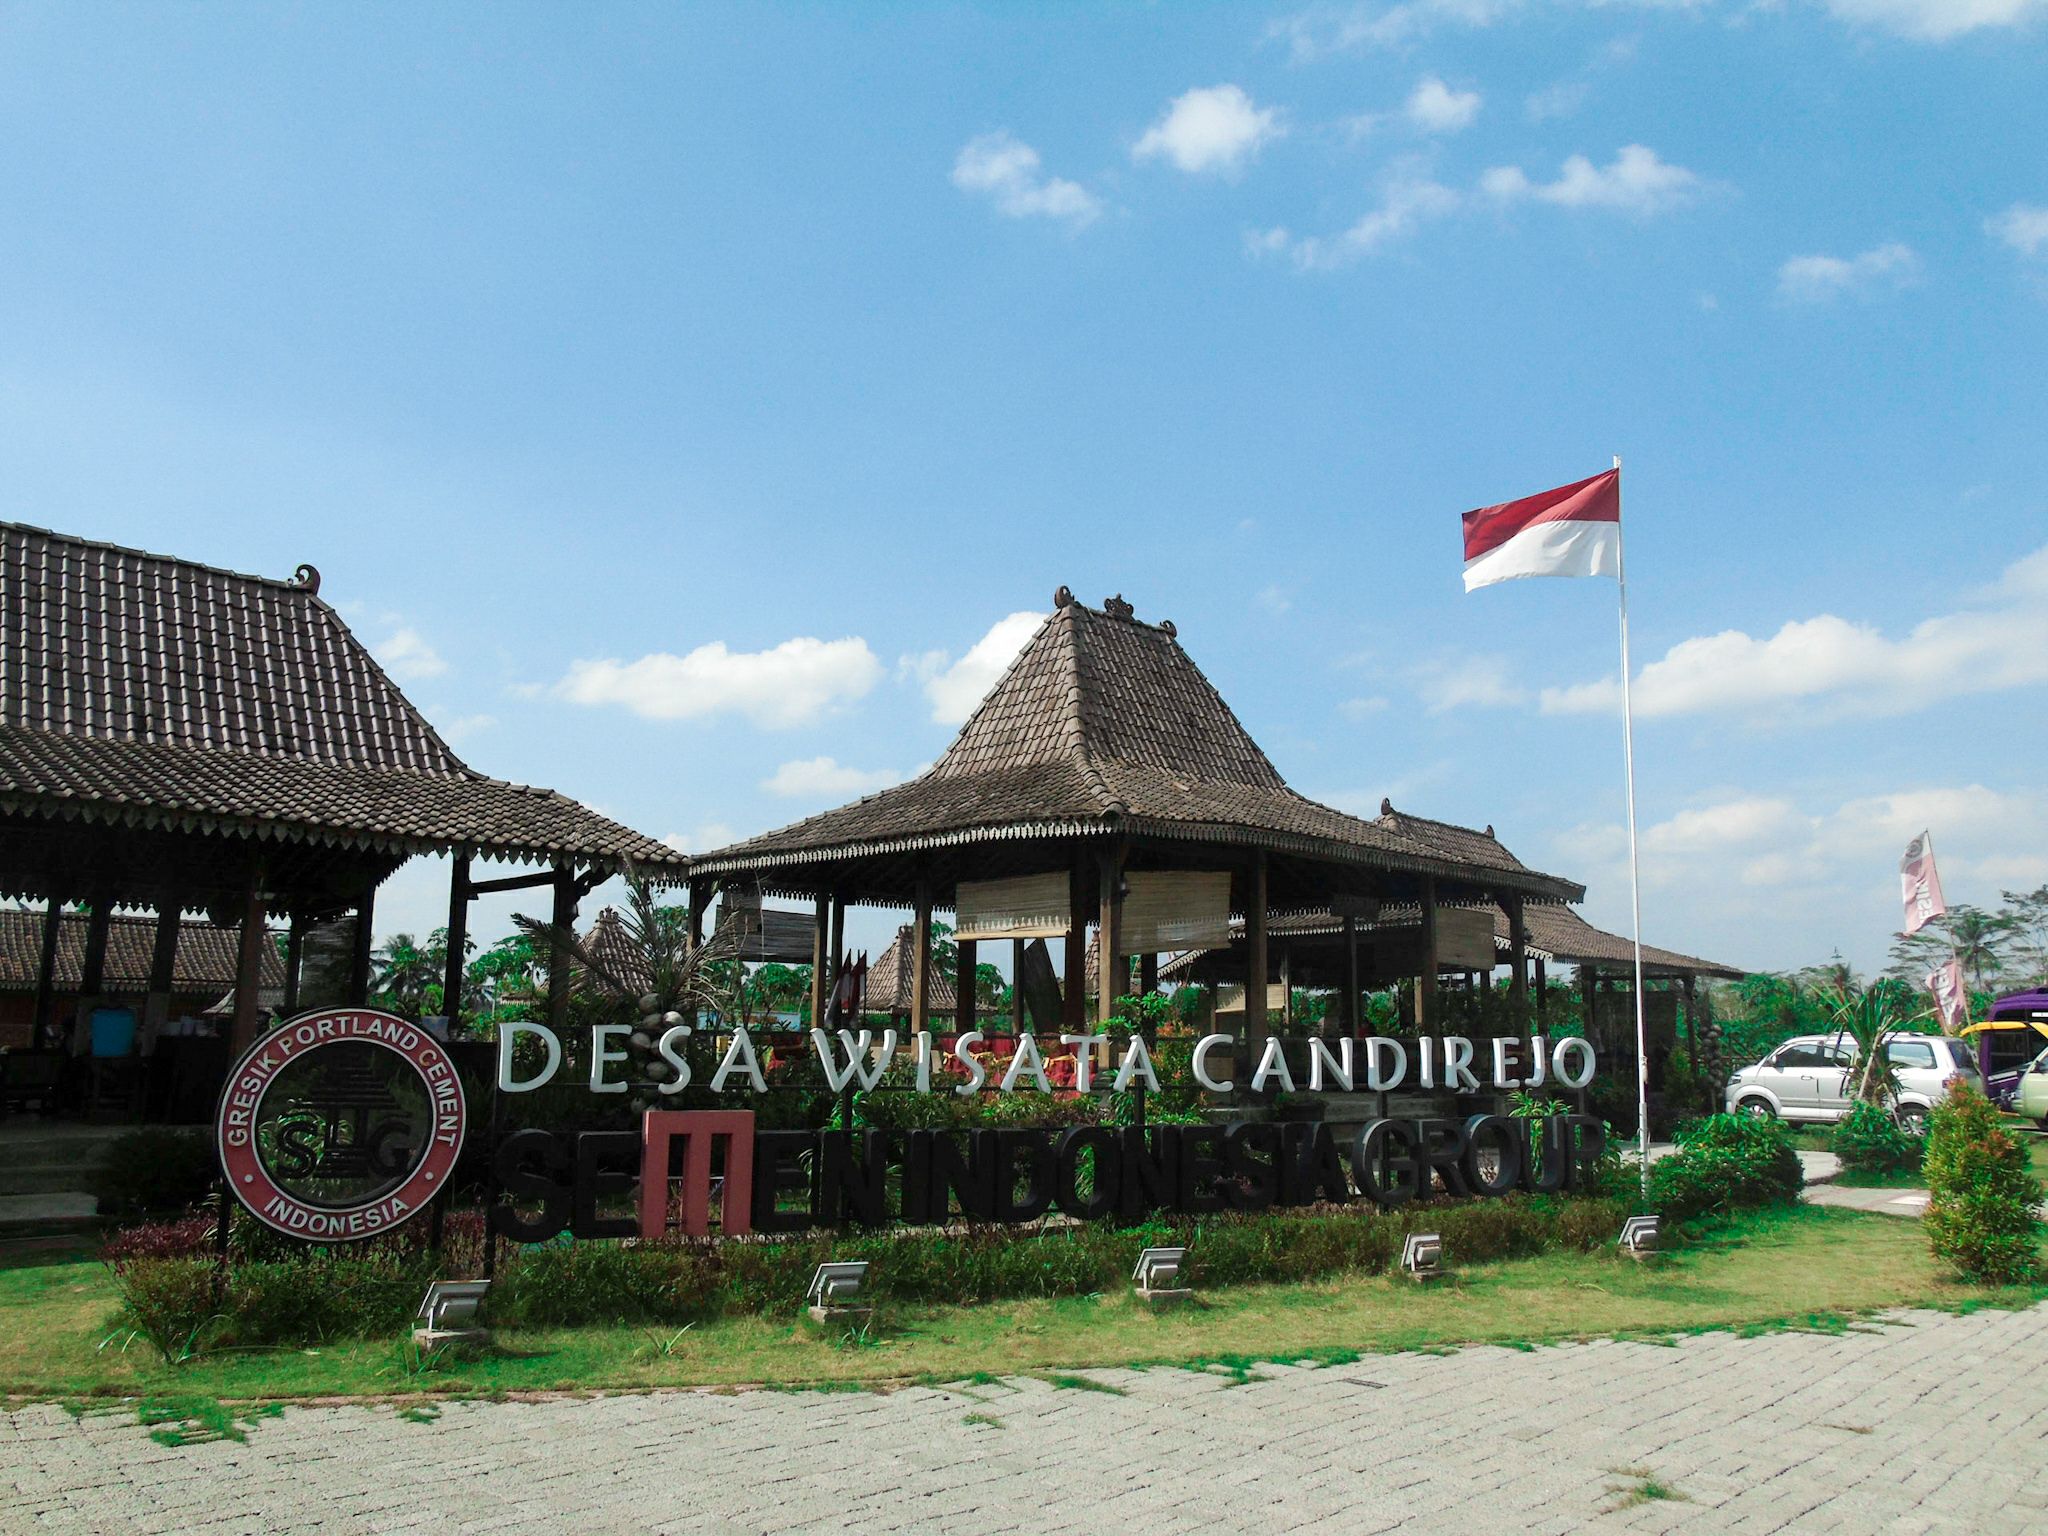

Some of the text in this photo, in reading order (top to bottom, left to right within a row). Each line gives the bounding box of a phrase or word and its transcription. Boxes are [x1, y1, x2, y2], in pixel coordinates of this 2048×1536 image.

[227, 1015, 459, 1148] GRESIK PORTLAND CEMENT
[498, 1021, 1597, 1096] DESA WISATA CANDIREJO
[262, 1195, 410, 1236] INDONESIA
[492, 1110, 1601, 1243] SEMEN INDONESIA GROUP
